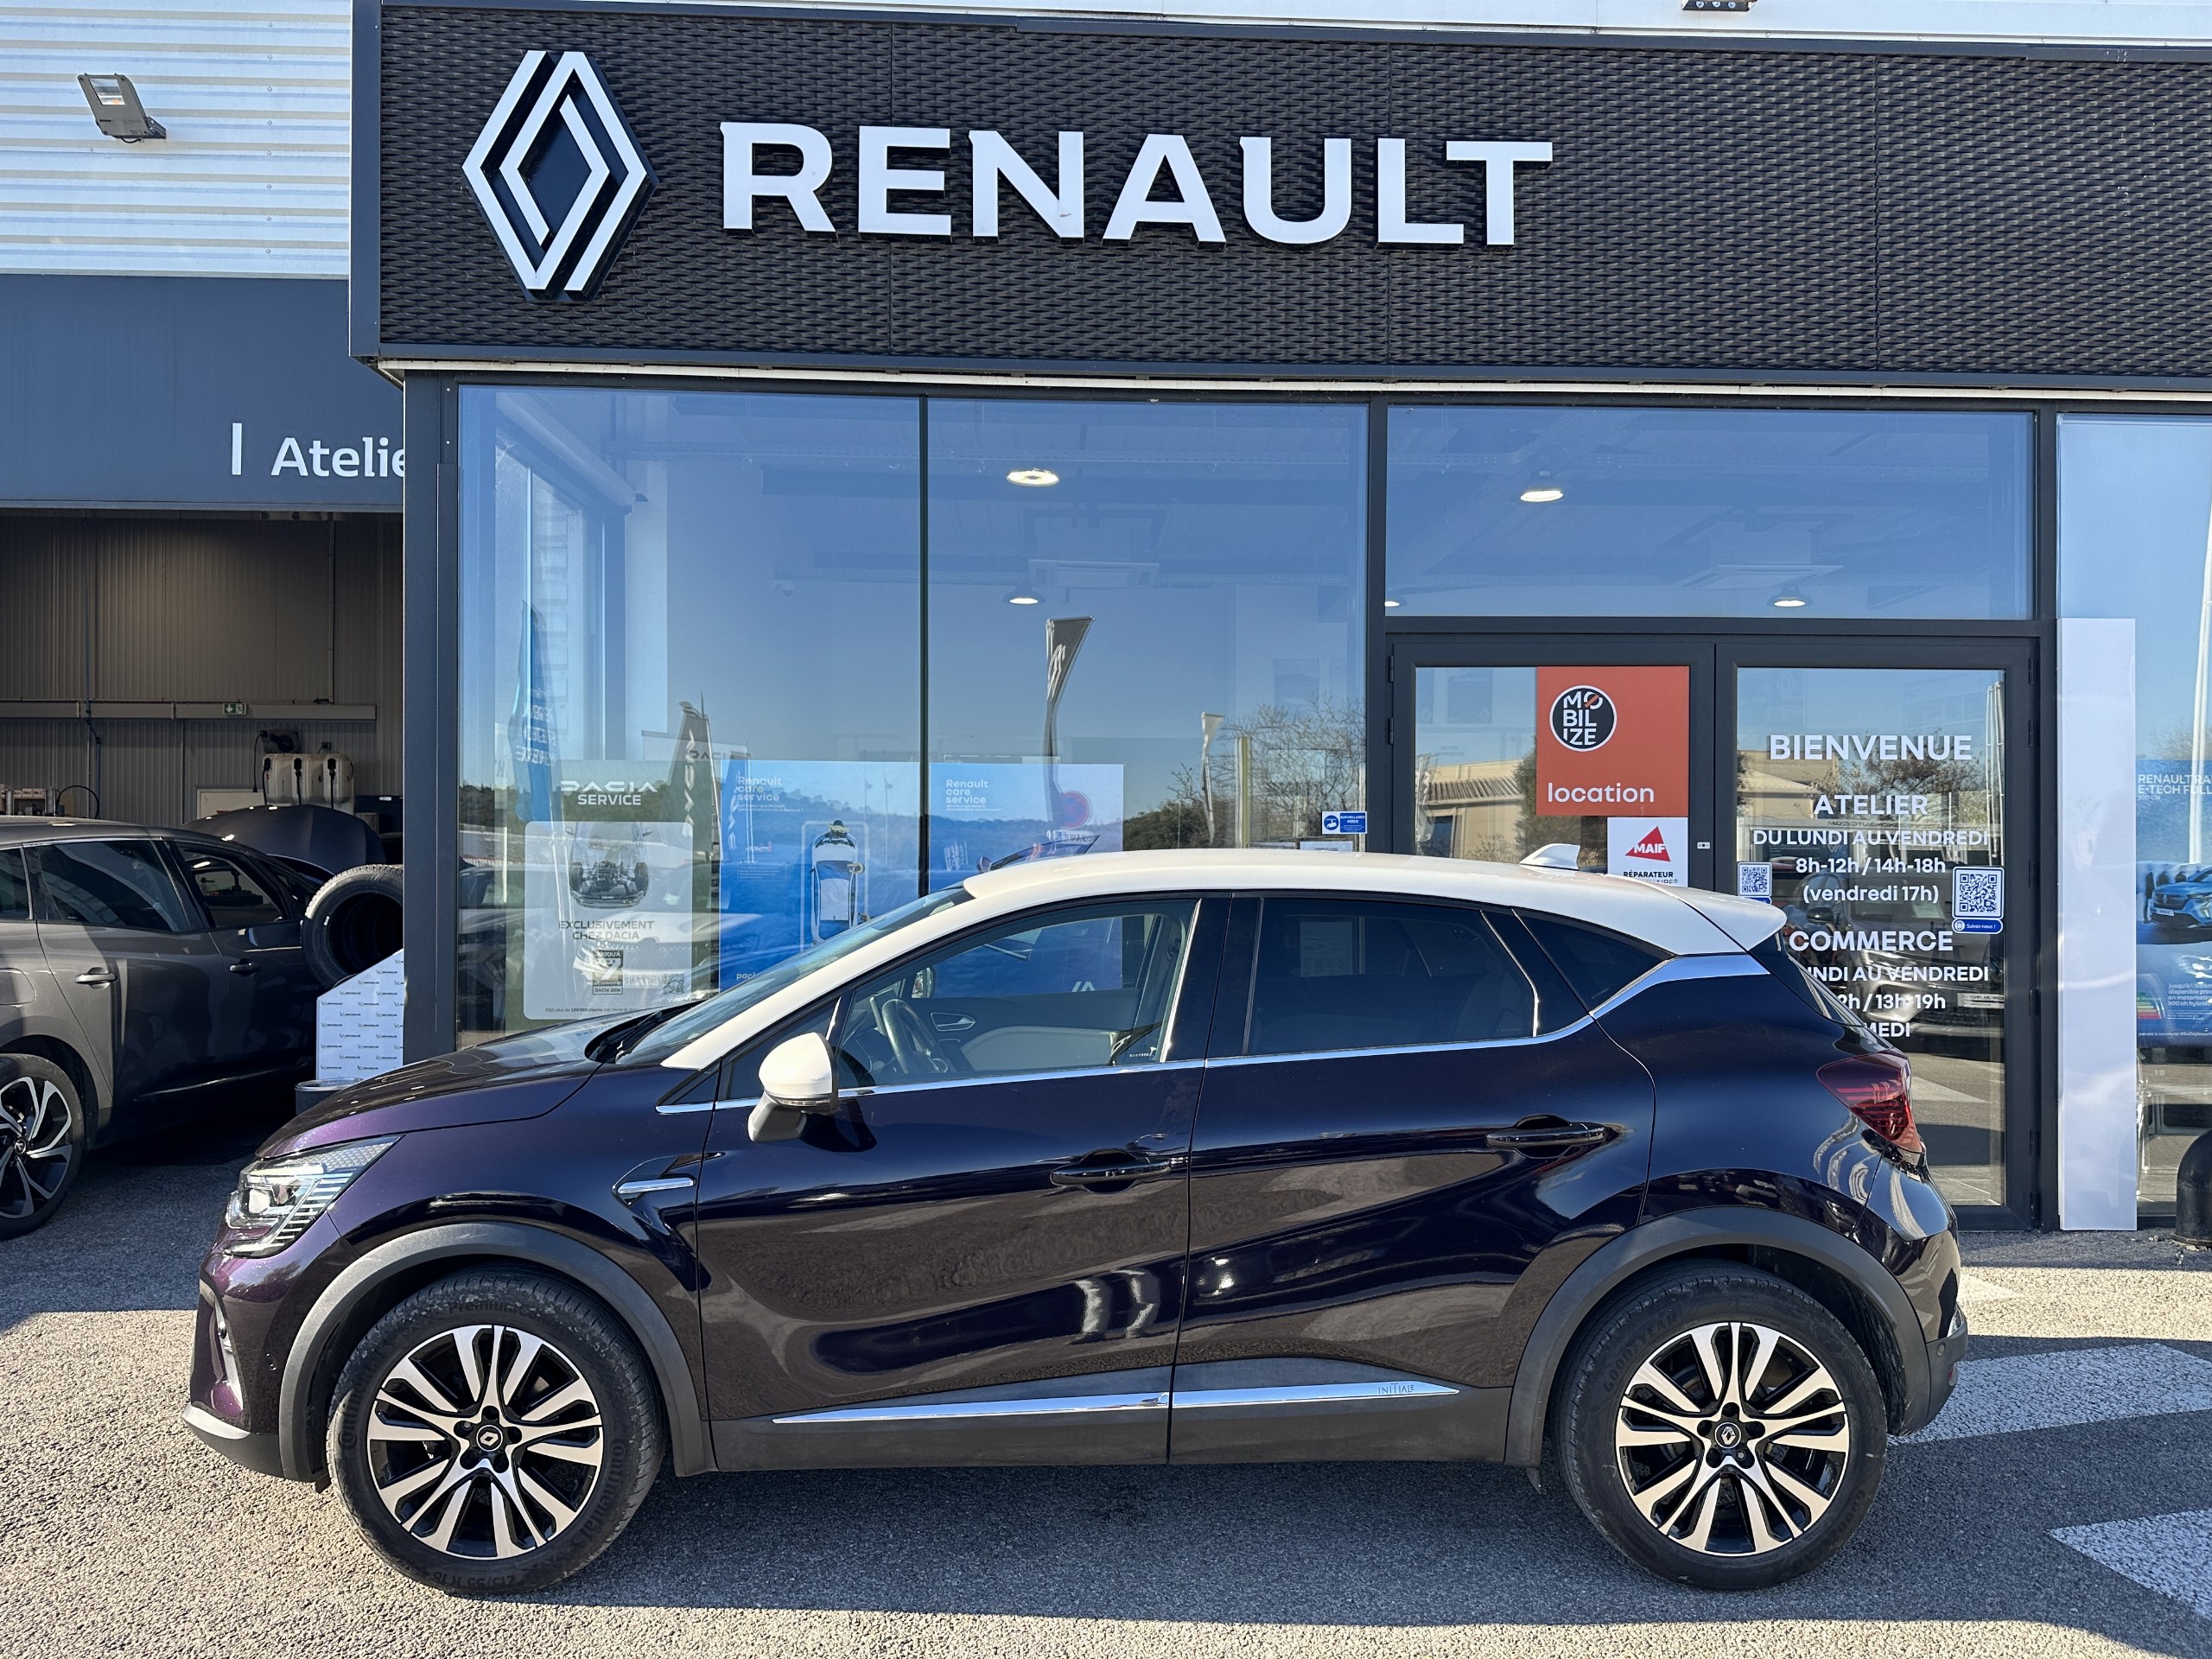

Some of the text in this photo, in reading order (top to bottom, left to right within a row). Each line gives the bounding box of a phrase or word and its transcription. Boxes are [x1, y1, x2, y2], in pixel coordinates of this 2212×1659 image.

[720, 122, 1553, 245] RENAULT
[1770, 734, 1973, 760] BIENVENUE
[738, 777, 782, 785] Renault
[946, 779, 988, 789] Renault
[2138, 773, 2191, 784] RENAULT
[561, 780, 658, 792] DACIA
[2138, 785, 2181, 794] E-TECH
[738, 792, 779, 802] service
[1548, 782, 1655, 803] location
[577, 794, 641, 805] SERVICE
[946, 795, 987, 804] service
[1814, 794, 1928, 815] ATELIER
[1753, 830, 1988, 846] DU LUNDI AU VENDREDI
[1634, 843, 1666, 854] MAIF
[1796, 858, 1859, 874] 8h-12h
[1875, 858, 1946, 874] 14h-18h
[1624, 869, 1673, 878] RÉPARATEUR
[1803, 886, 1940, 904] (vendredi 17h)
[559, 921, 654, 930] EXCLUSIVEMENT
[572, 931, 639, 940] CHEZ DACIA
[1789, 931, 1954, 951] COMMERCE
[1808, 967, 1988, 982] NDI AU VENDREDI
[1876, 995, 1946, 1009] 13h-19h
[1866, 1023, 1910, 1037] MEDI
[1378, 1382, 1414, 1394] INITIALE
